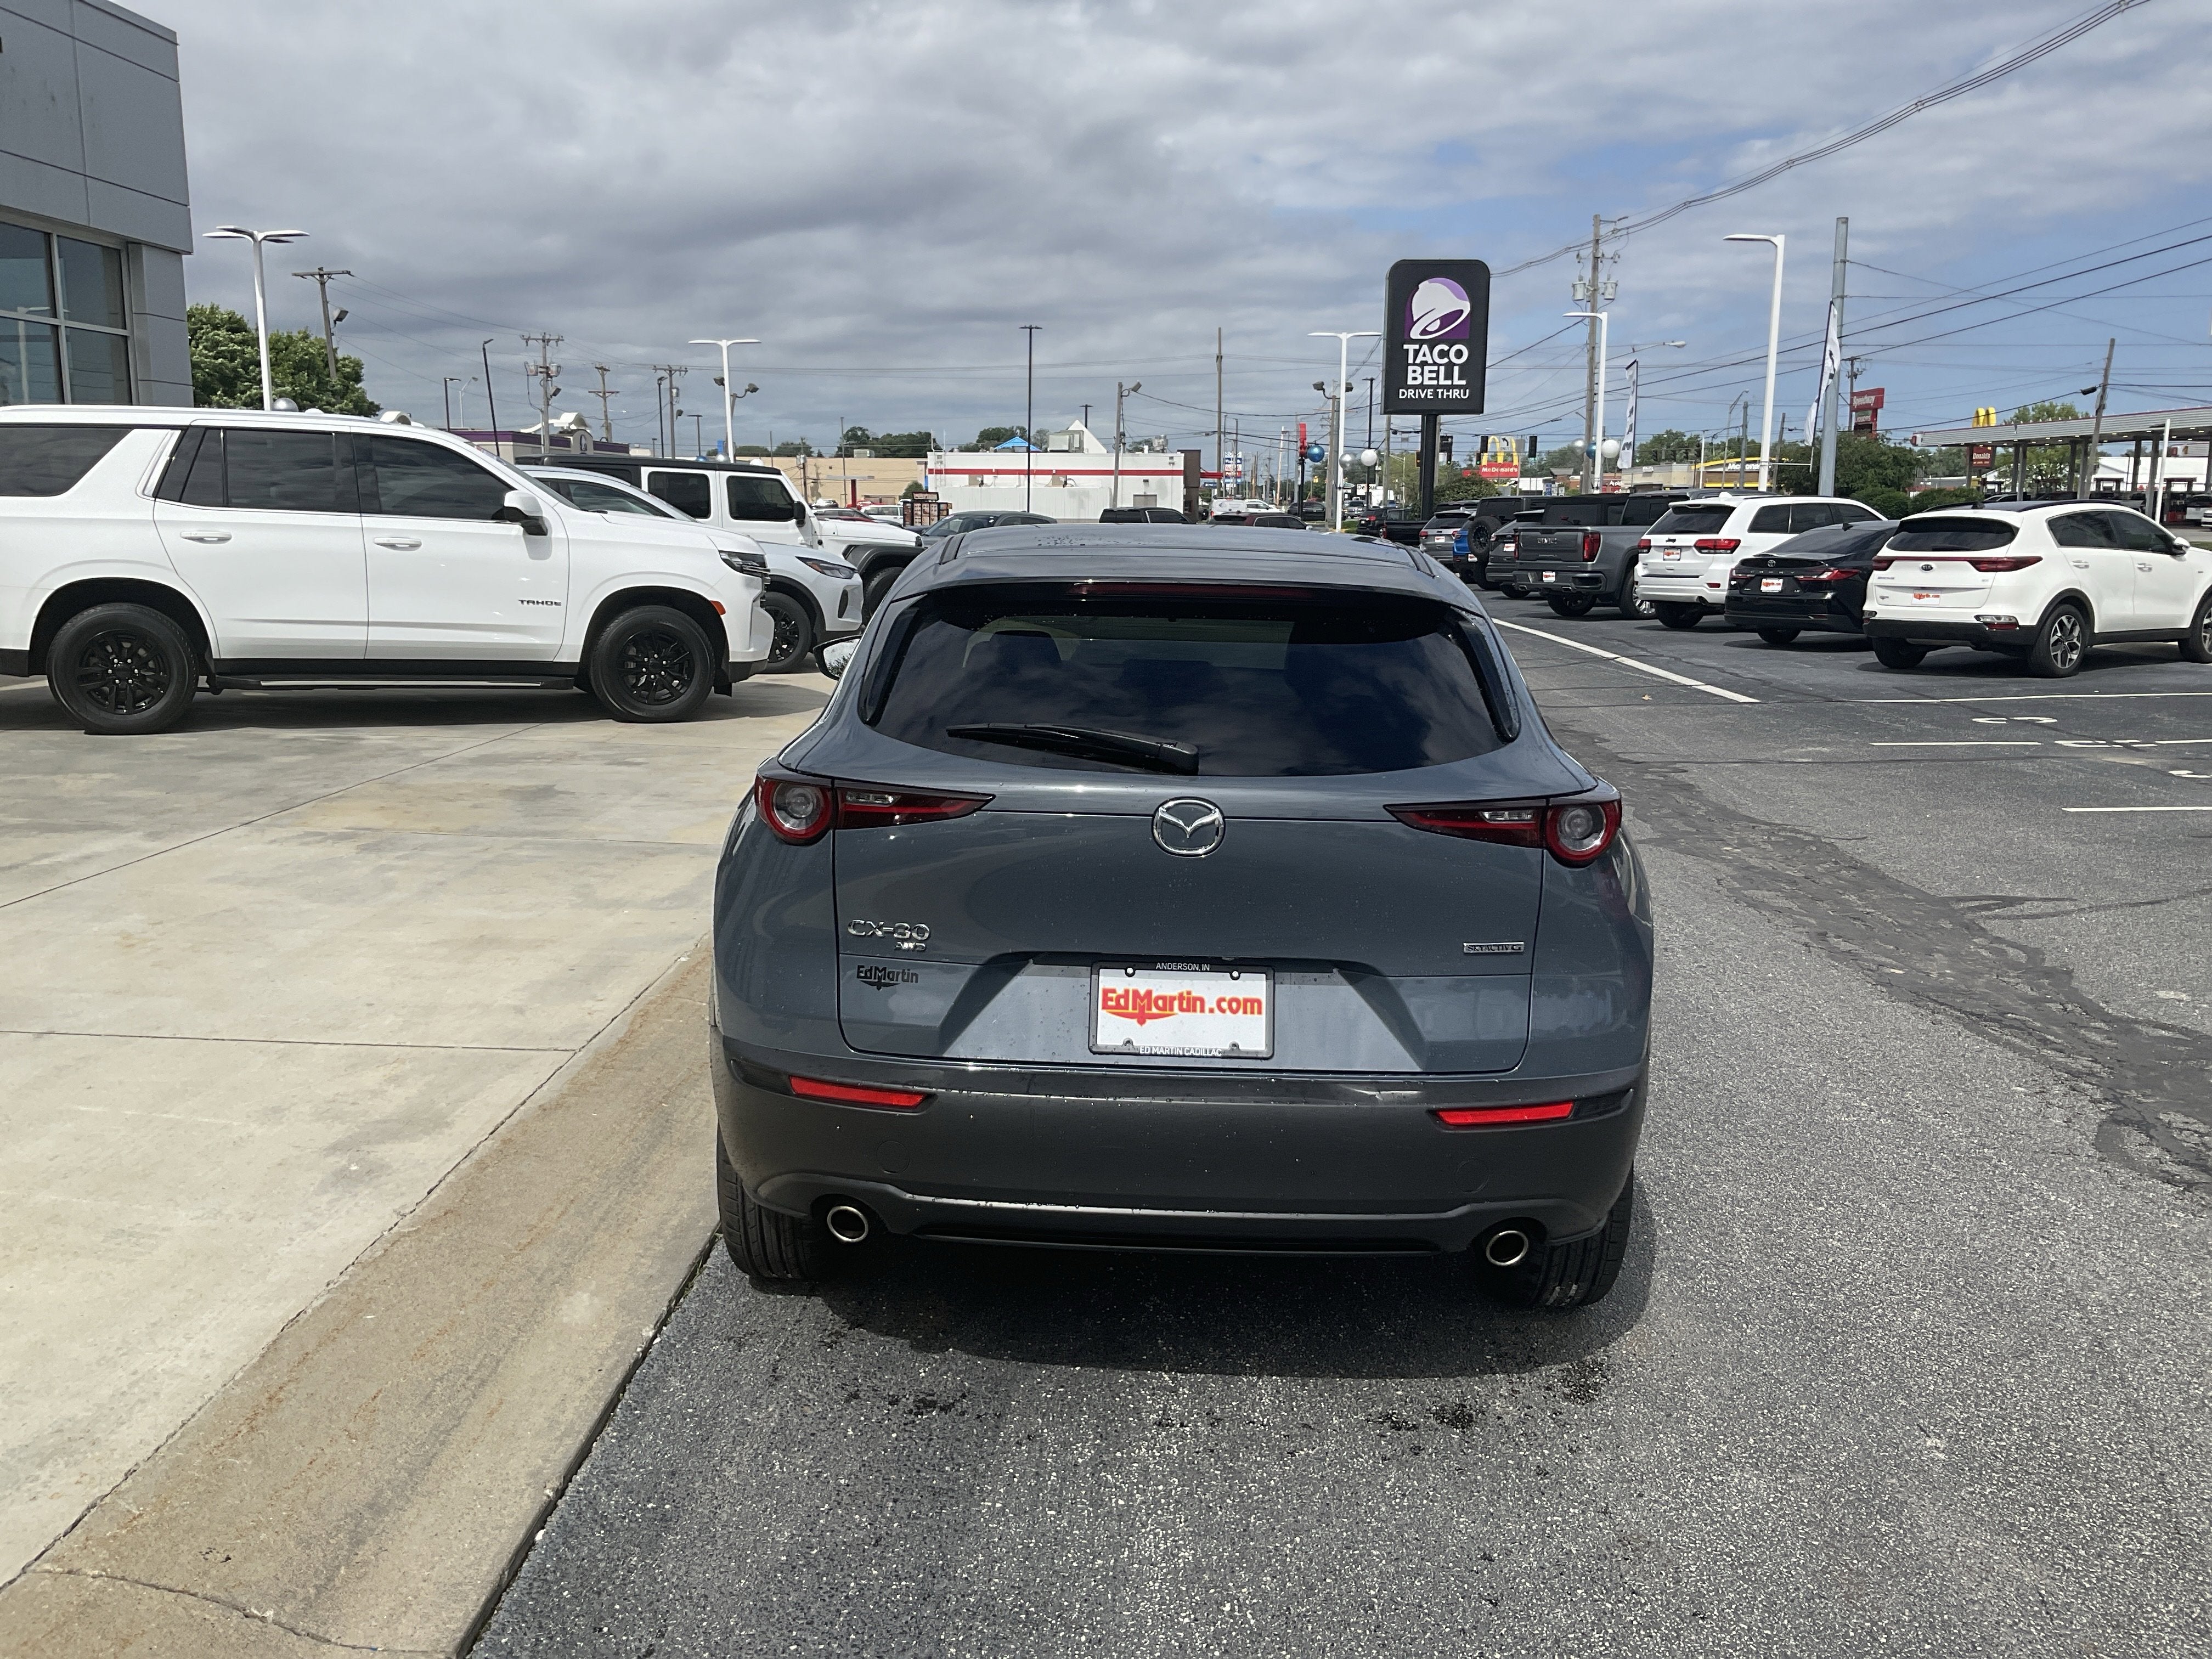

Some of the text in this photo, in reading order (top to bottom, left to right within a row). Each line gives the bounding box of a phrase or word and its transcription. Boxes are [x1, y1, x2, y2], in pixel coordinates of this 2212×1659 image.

[1403, 344, 1469, 364] TACO
[1407, 365, 1466, 385] BELL
[1399, 389, 1469, 399] DRIVE THRU
[848, 919, 931, 940] CX-30
[856, 964, 919, 984] EdMartin
[1102, 987, 1262, 1015] EdMartin.com
[1152, 1047, 1182, 1055] MARTIN
[1184, 1047, 1222, 1057] CADILLAC
